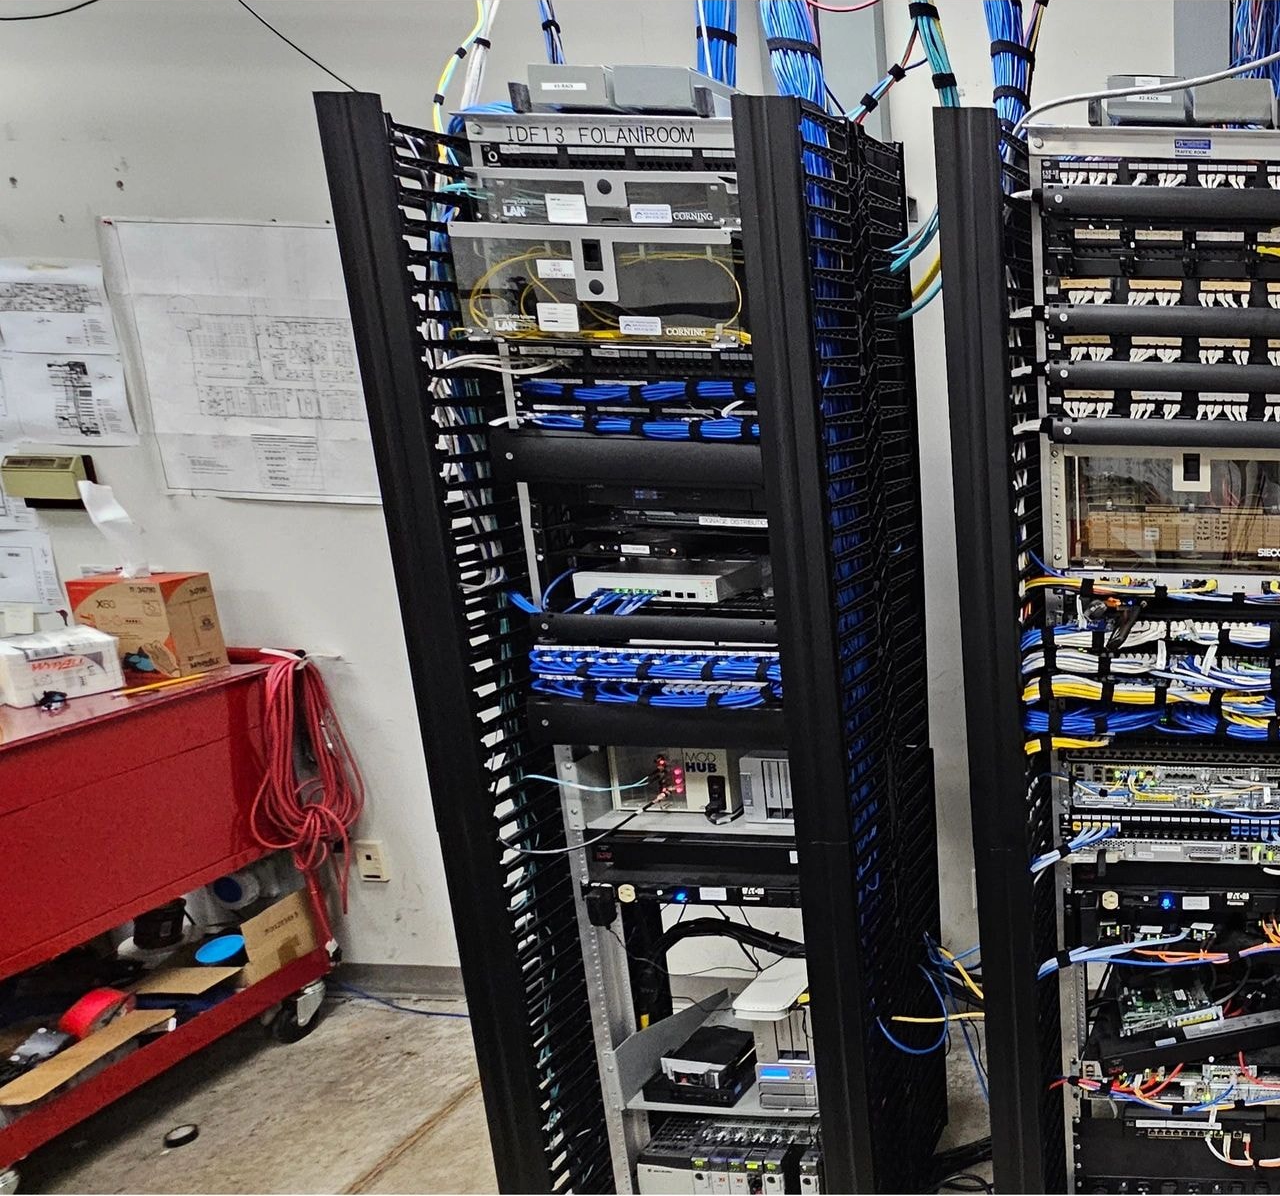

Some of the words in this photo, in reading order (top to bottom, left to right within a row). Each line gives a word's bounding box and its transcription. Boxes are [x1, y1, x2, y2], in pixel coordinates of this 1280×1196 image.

[506, 125, 565, 143] IDF13
[502, 205, 527, 217] LAN
[673, 211, 713, 221] CORNING
[494, 321, 516, 332] LAN
[666, 327, 706, 337] CORNING
[685, 752, 716, 763] MOD
[685, 762, 717, 773] HUB
